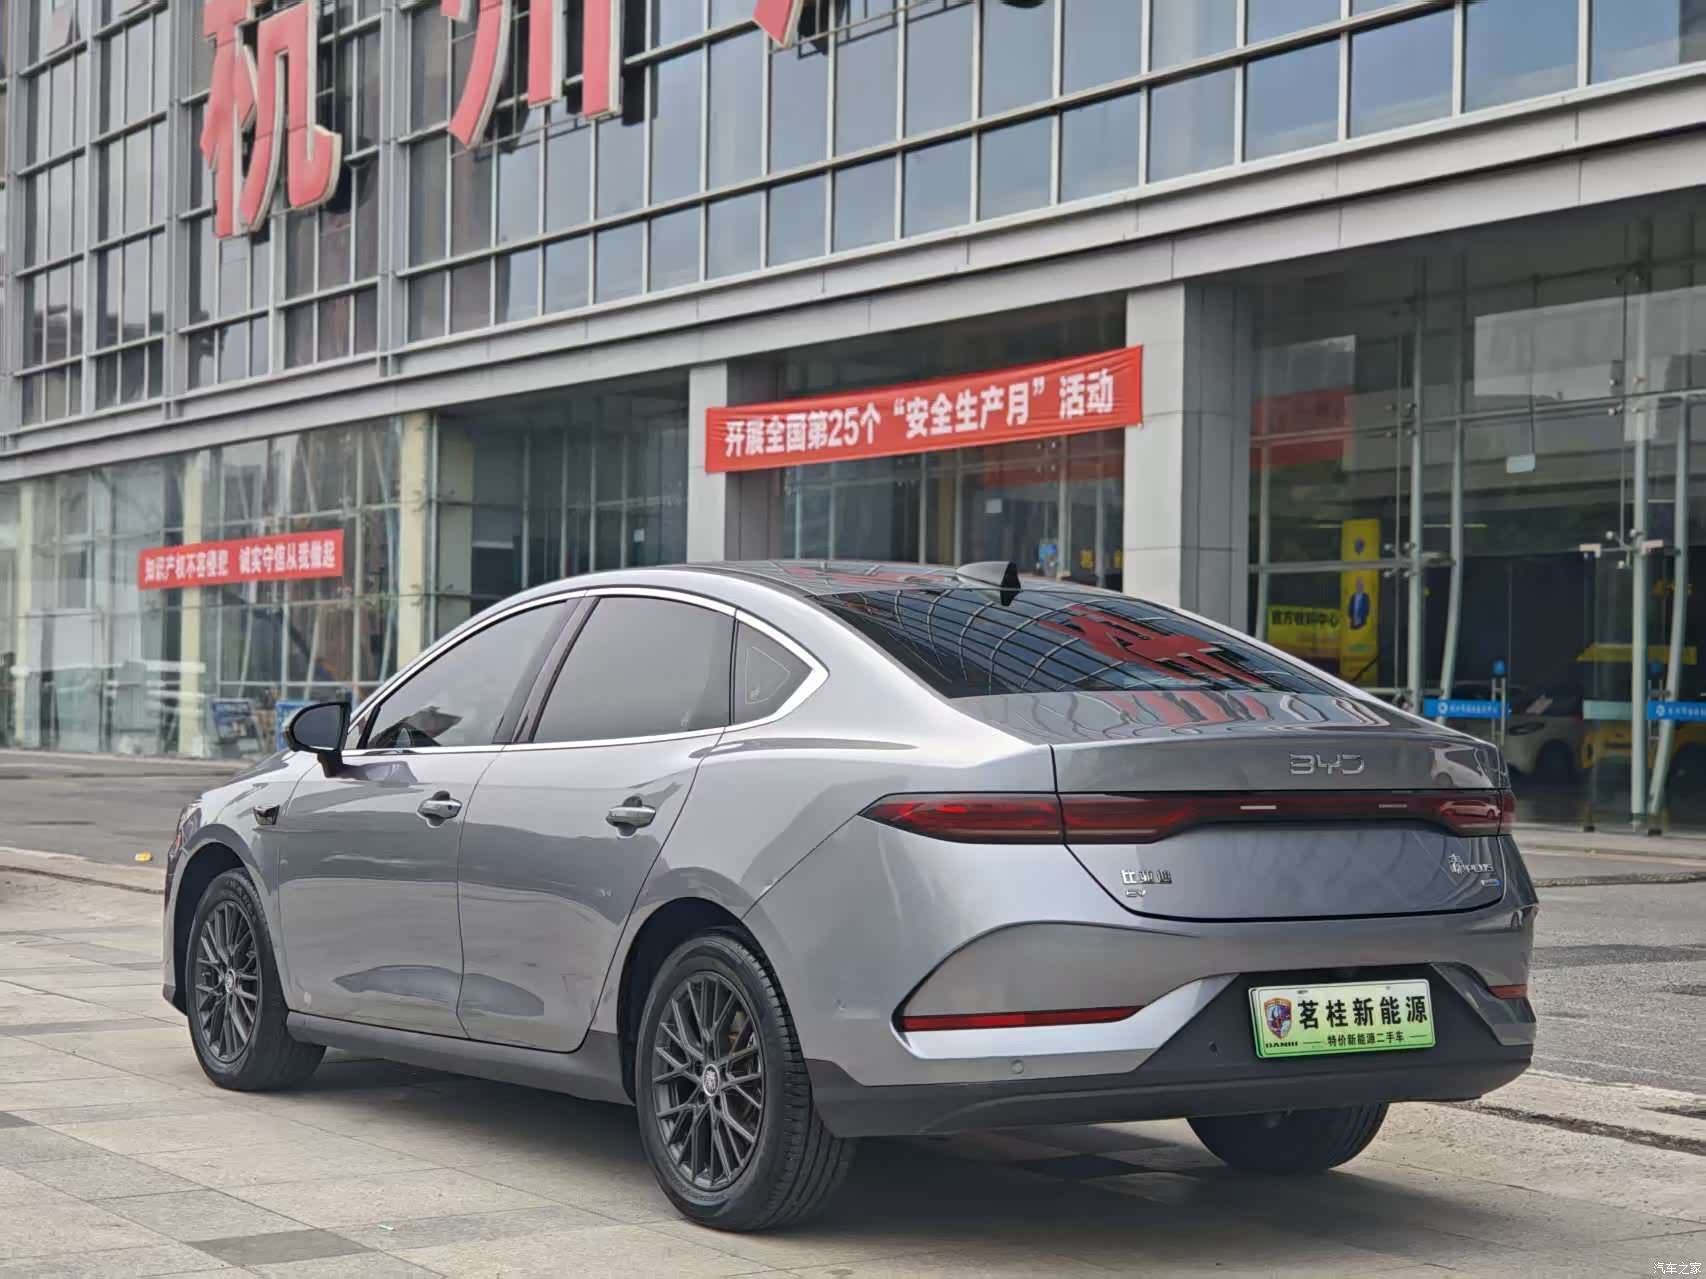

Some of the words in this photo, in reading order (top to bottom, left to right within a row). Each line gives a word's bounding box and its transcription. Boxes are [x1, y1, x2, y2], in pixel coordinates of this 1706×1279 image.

[1289, 754, 1364, 774] BYD
[1297, 995, 1428, 1030] 茗桂新能源
[1327, 1031, 1404, 1048] 特价新能源二手车
